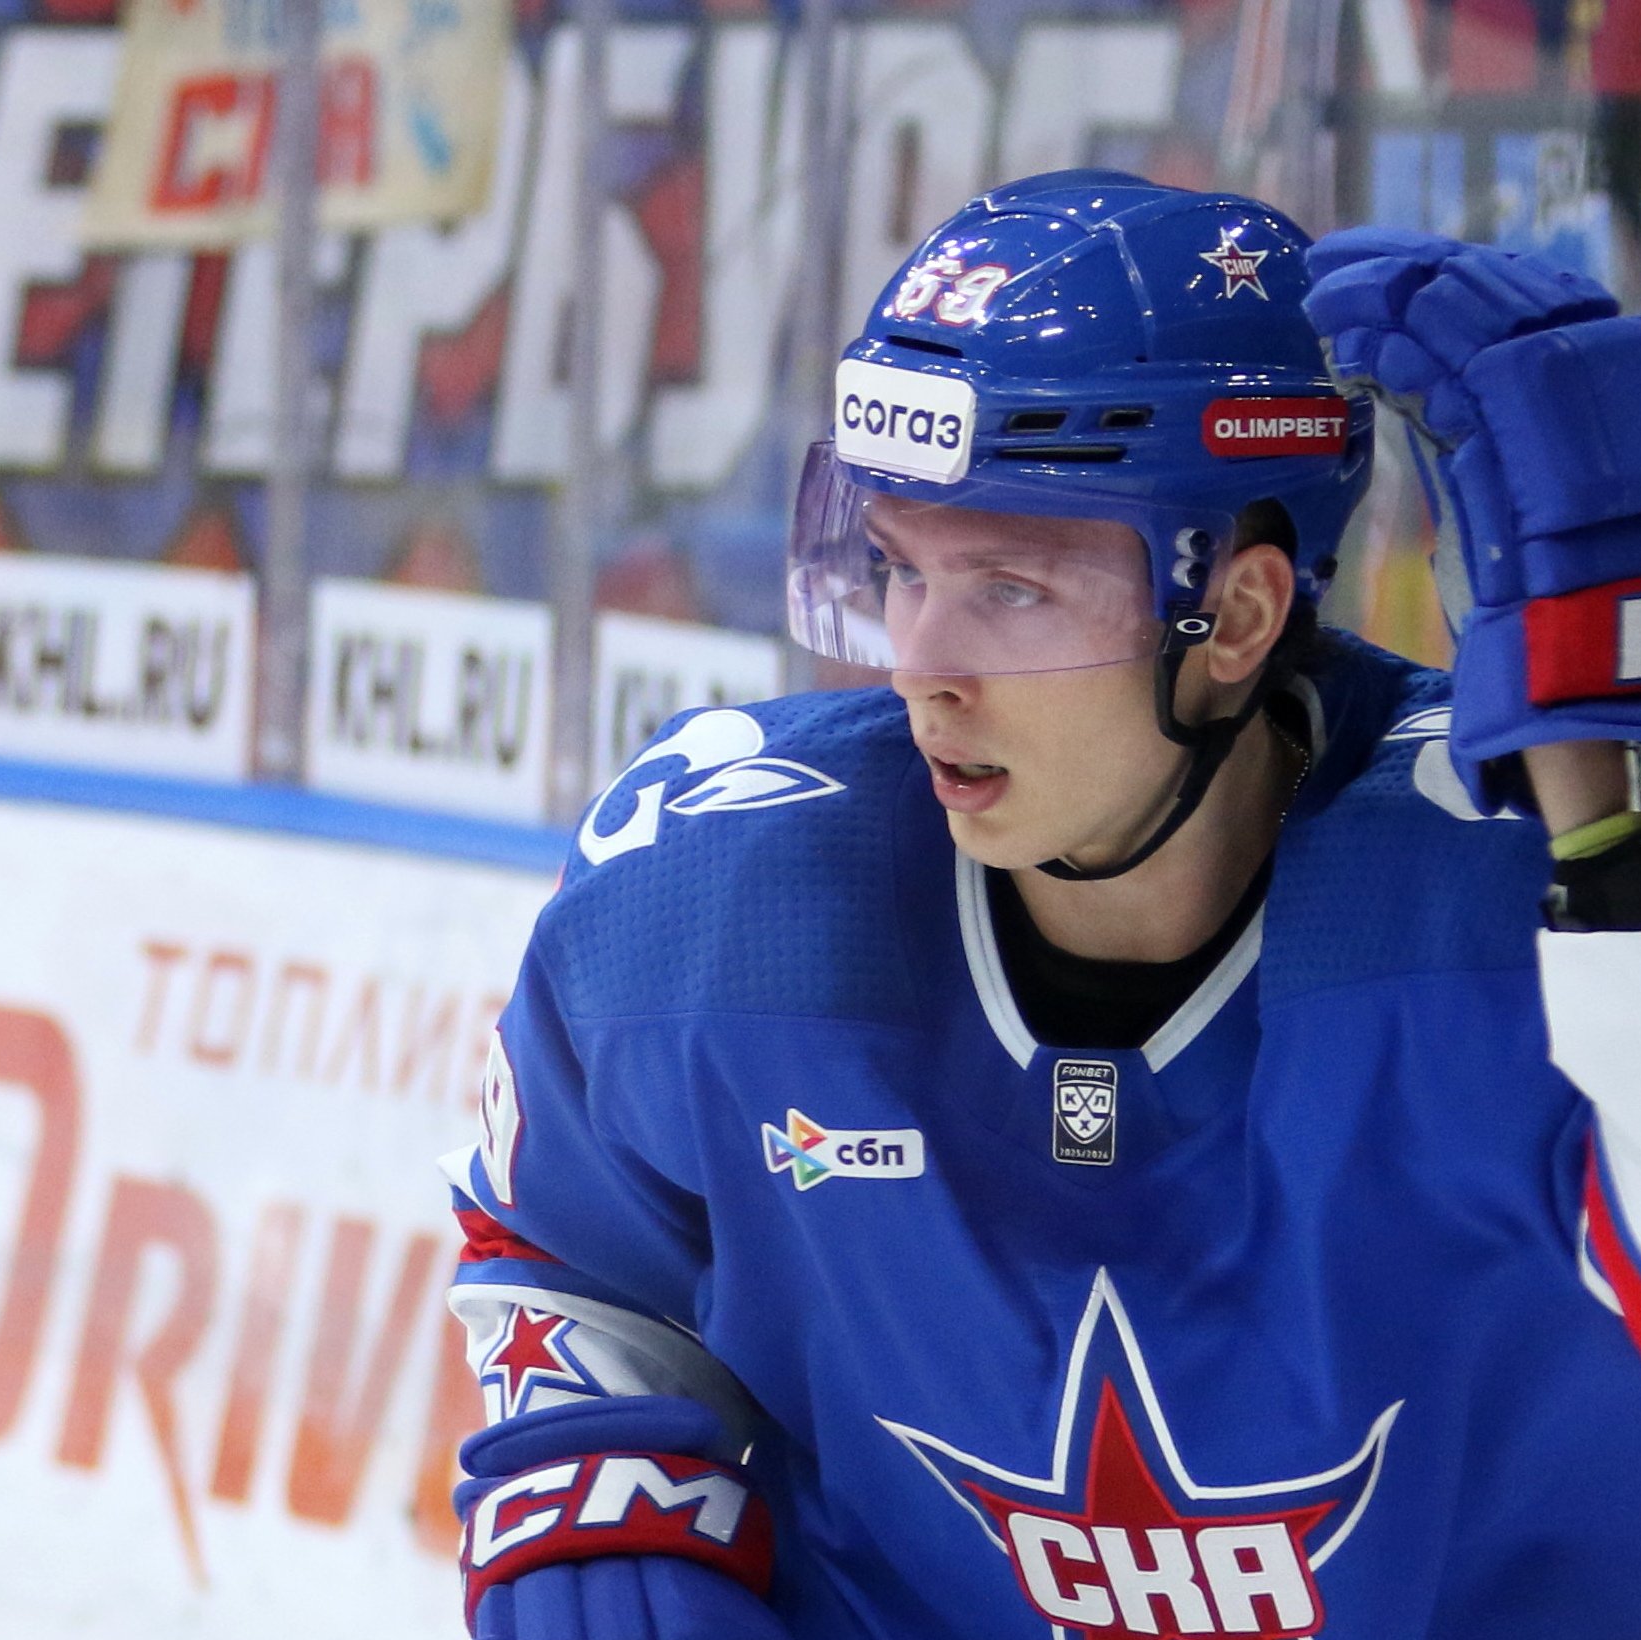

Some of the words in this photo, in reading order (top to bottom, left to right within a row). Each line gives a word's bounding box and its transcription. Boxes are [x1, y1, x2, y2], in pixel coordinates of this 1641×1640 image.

[1214, 417, 1345, 439] OLIMPBET
[333, 628, 535, 768] KHL.RU
[1062, 1065, 1111, 1078] FONBET
[836, 1137, 904, 1167] сбп
[1007, 1512, 1315, 1635] СКА
